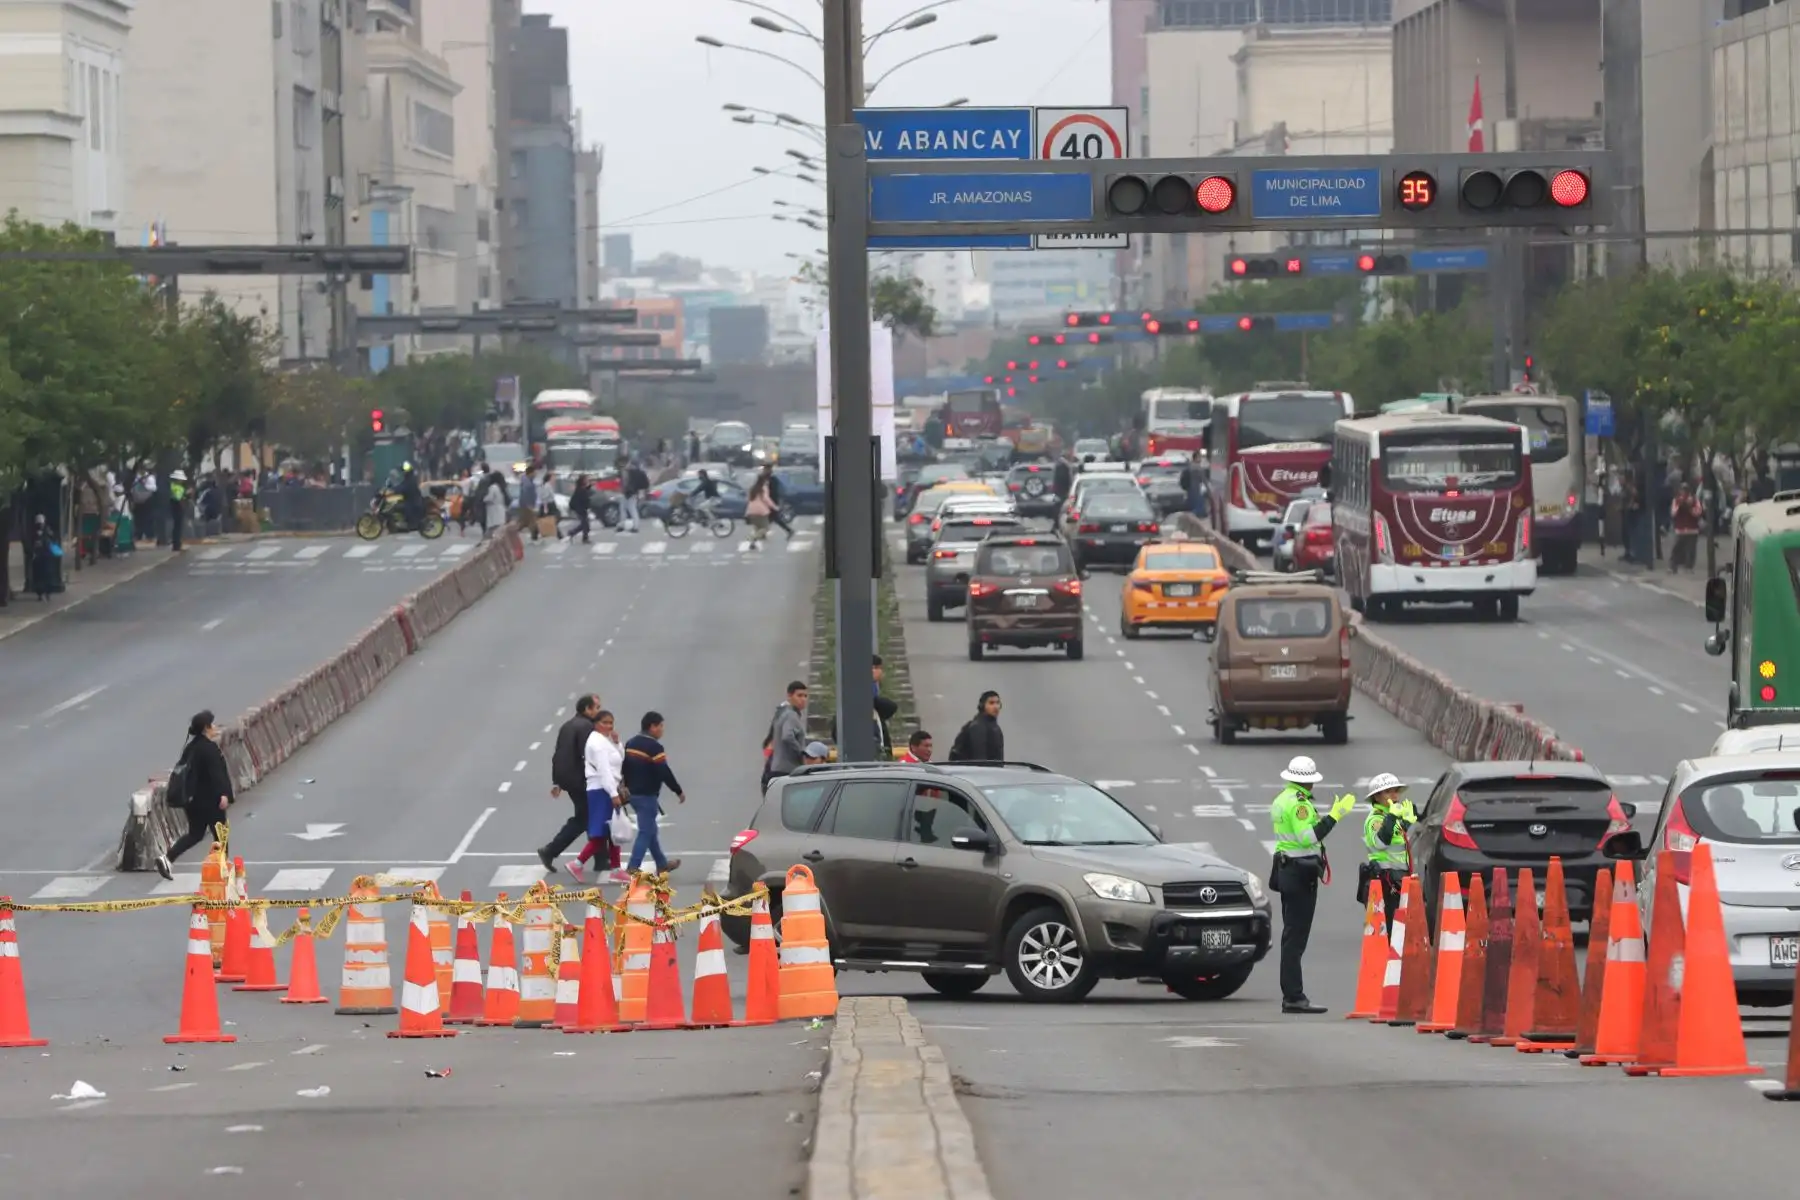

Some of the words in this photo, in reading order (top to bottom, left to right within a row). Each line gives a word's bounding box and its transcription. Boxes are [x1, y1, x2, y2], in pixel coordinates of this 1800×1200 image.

[864, 129, 883, 150] V.
[898, 129, 1022, 150] ABANCAY
[1060, 133, 1103, 159] 40
[1266, 177, 1366, 191] MUNICIPALIDAD
[1403, 179, 1429, 203] 35
[930, 192, 950, 204] JR.
[953, 190, 1033, 204] AMAZONAS
[1290, 195, 1308, 207] DE
[1311, 195, 1341, 207] LIMA
[1270, 469, 1318, 481] Etusa
[1429, 508, 1477, 522] Etusa
